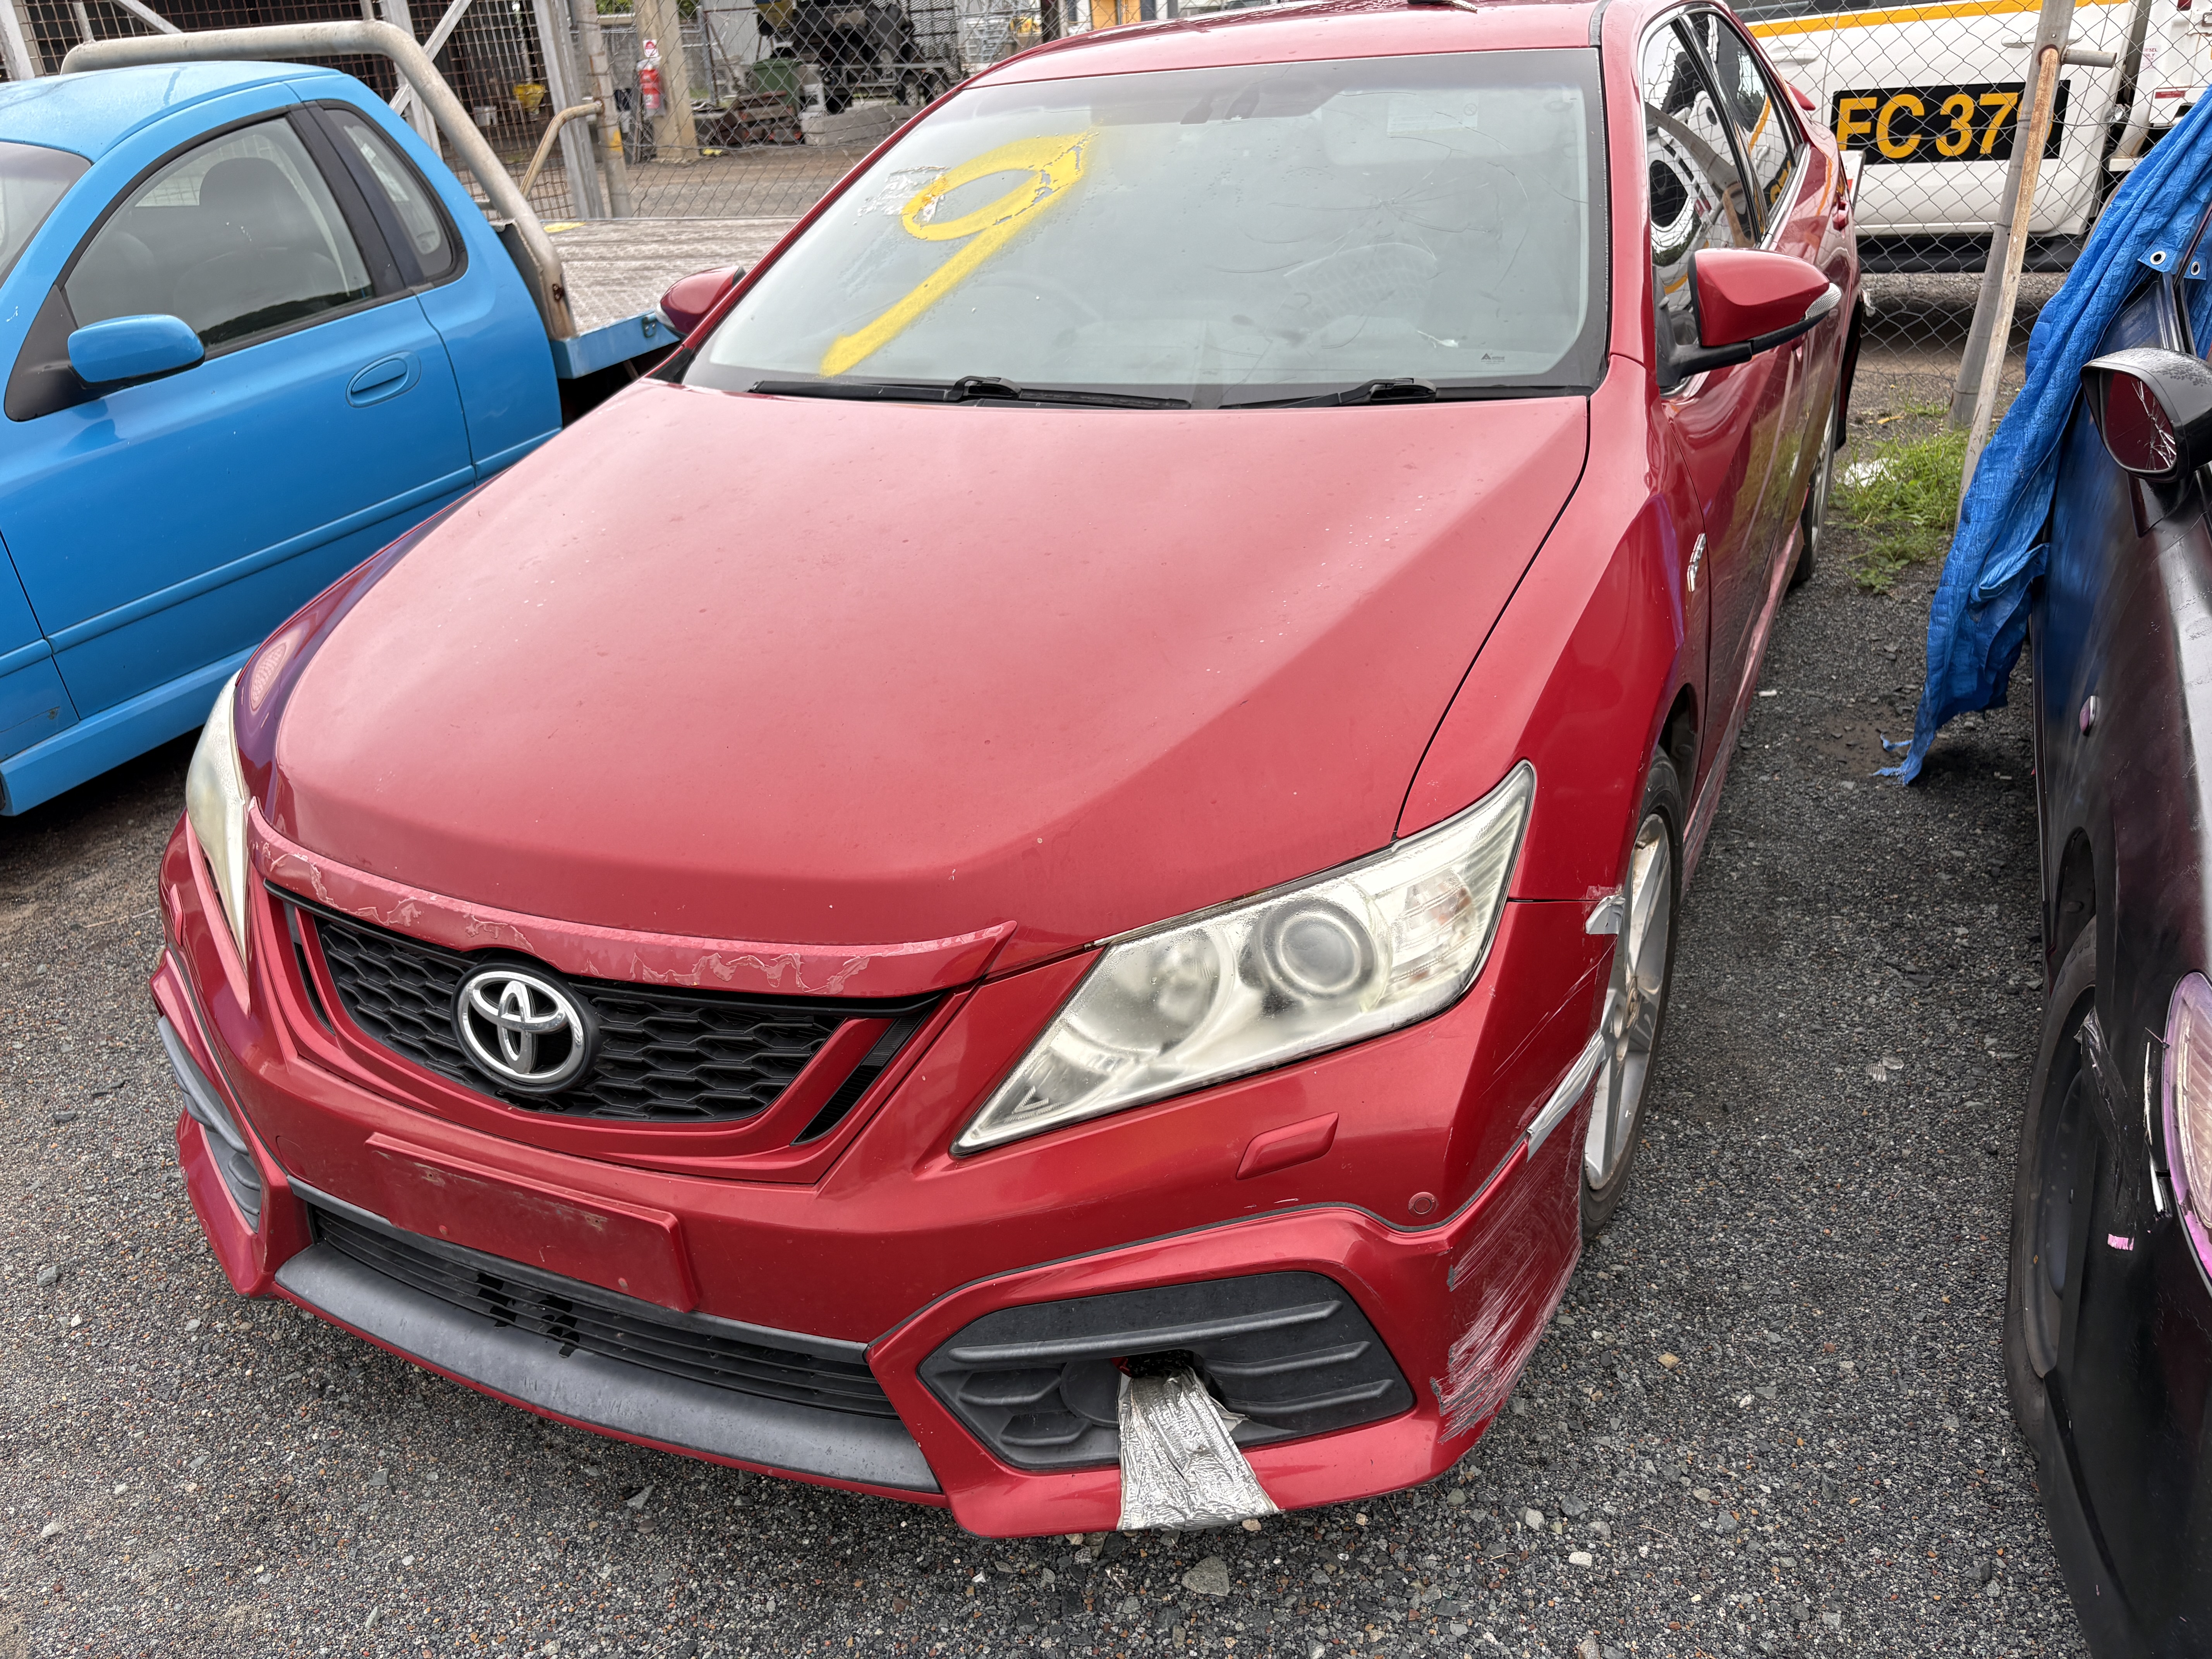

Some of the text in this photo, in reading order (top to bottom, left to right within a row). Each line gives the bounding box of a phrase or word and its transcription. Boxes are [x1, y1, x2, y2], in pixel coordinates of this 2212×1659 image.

[1836, 93, 2054, 158] FC 37
[819, 131, 1089, 378] 9
